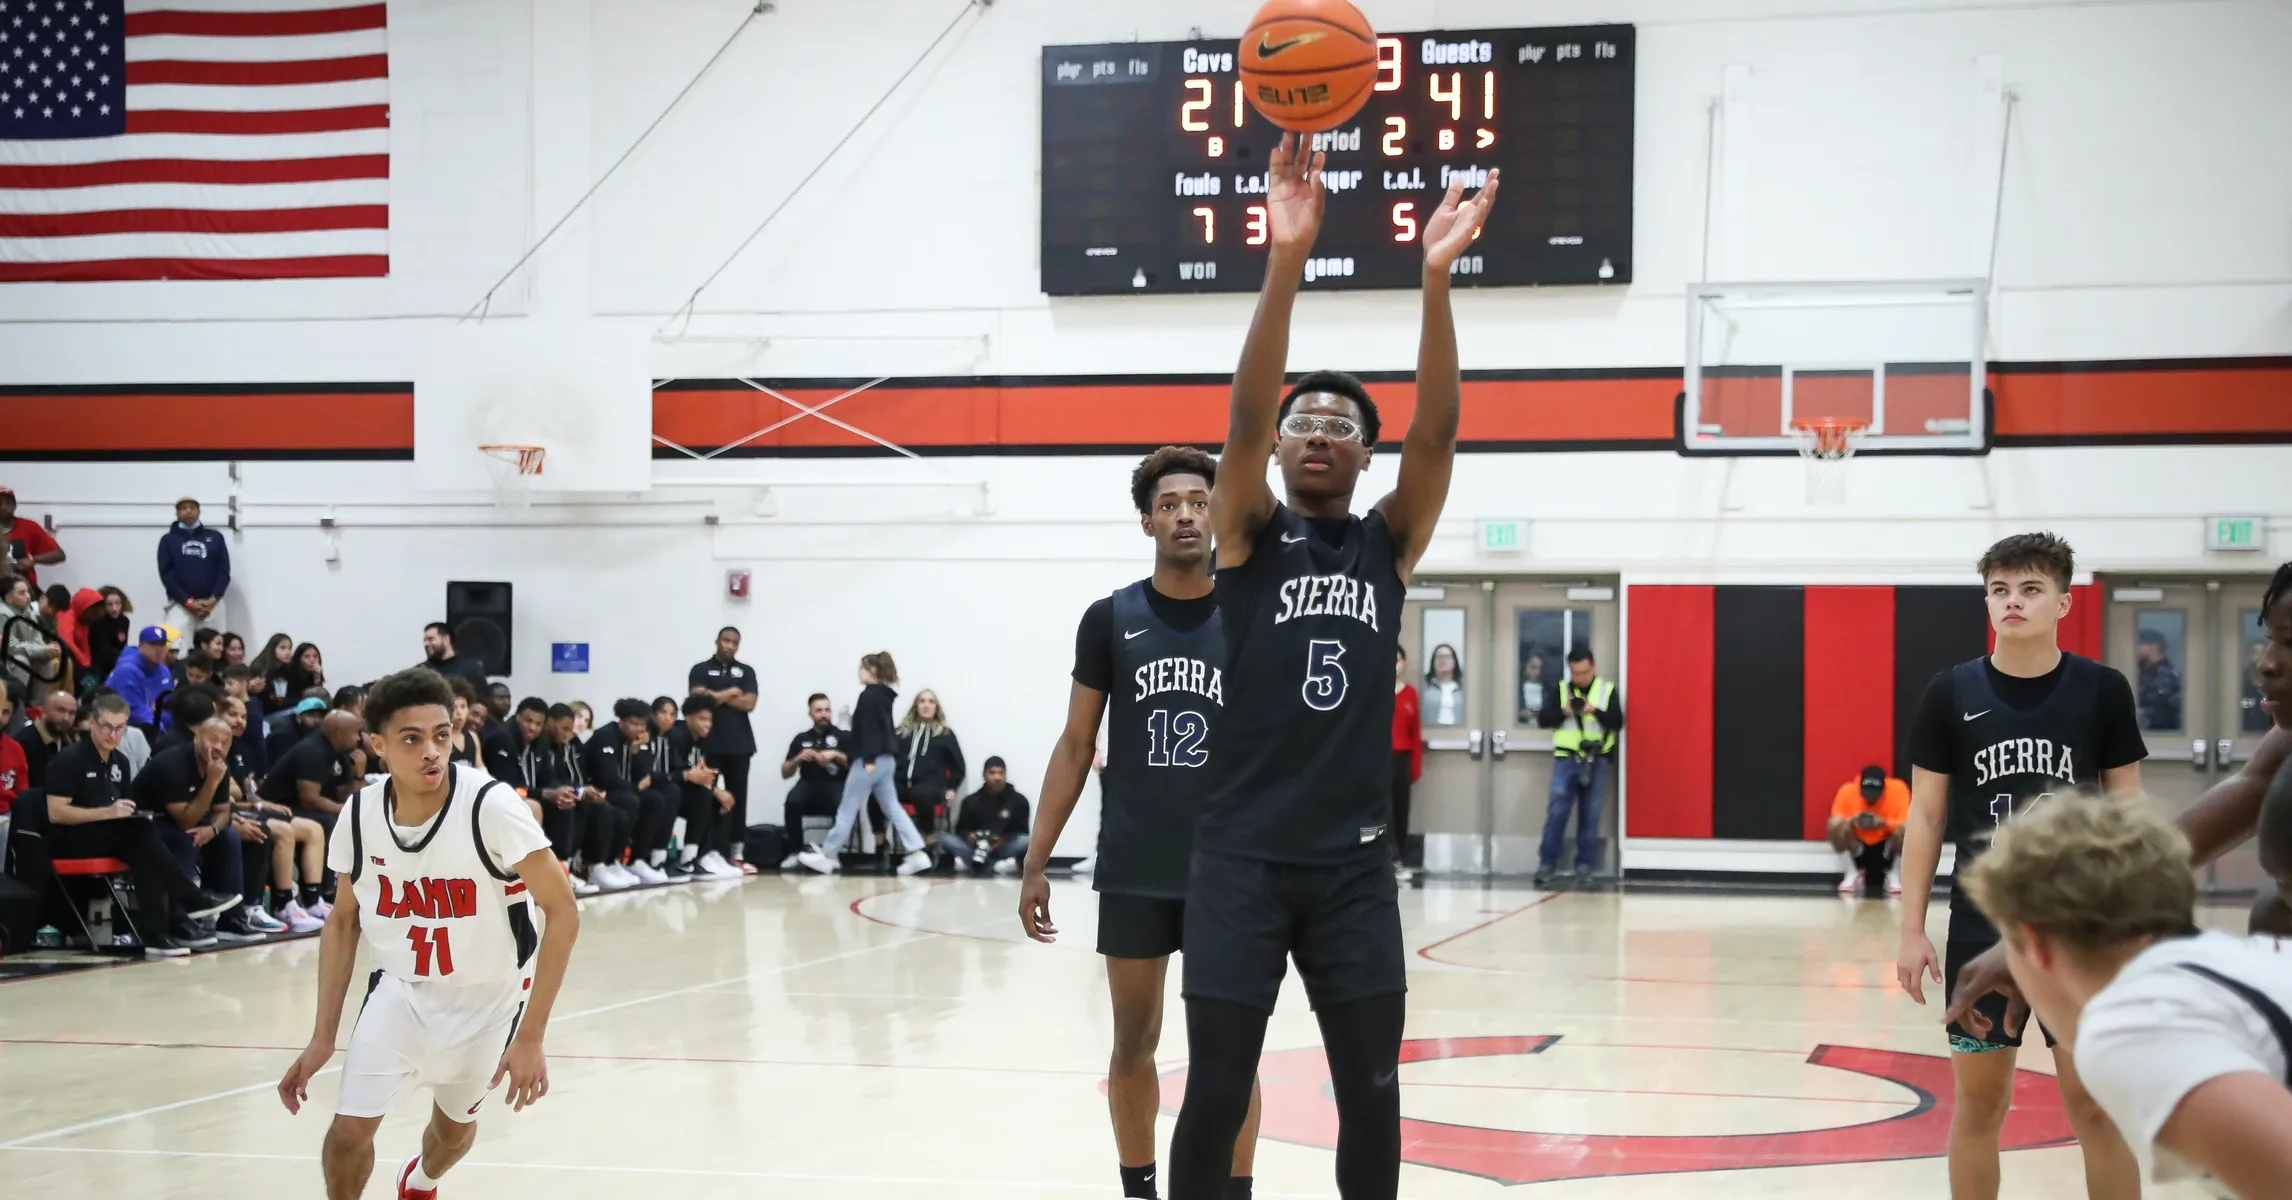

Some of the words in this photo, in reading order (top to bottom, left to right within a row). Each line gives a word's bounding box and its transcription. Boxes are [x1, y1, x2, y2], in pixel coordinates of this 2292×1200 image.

[1183, 47, 1233, 73] Cavs
[1422, 38, 1492, 64] Guests
[1556, 43, 1582, 62] pts
[1092, 61, 1116, 79] pts
[1181, 79, 1244, 132] 21
[1257, 82, 1330, 106] ELITE
[1429, 70, 1494, 121] 41
[1208, 136, 1224, 157] B
[1300, 126, 1361, 152] eriod
[1382, 116, 1406, 156] 2
[1438, 129, 1455, 150] B
[1175, 172, 1221, 196] fouls
[1235, 171, 1270, 194] t.o.l
[1192, 207, 1214, 244] 7
[1245, 206, 1267, 245] 3
[1392, 202, 1417, 242] 5
[1179, 261, 1217, 280] won
[1304, 257, 1355, 282] game
[1486, 523, 1517, 548] EXIT
[2217, 520, 2252, 546] EXIT
[1275, 574, 1379, 632] SIERRA
[1135, 657, 1224, 707] SIERRA
[1302, 639, 1349, 711] 5
[1148, 709, 1209, 768] 12
[1973, 737, 2076, 787] SIERRA
[376, 874, 477, 919] LAND
[406, 925, 455, 977] 11
